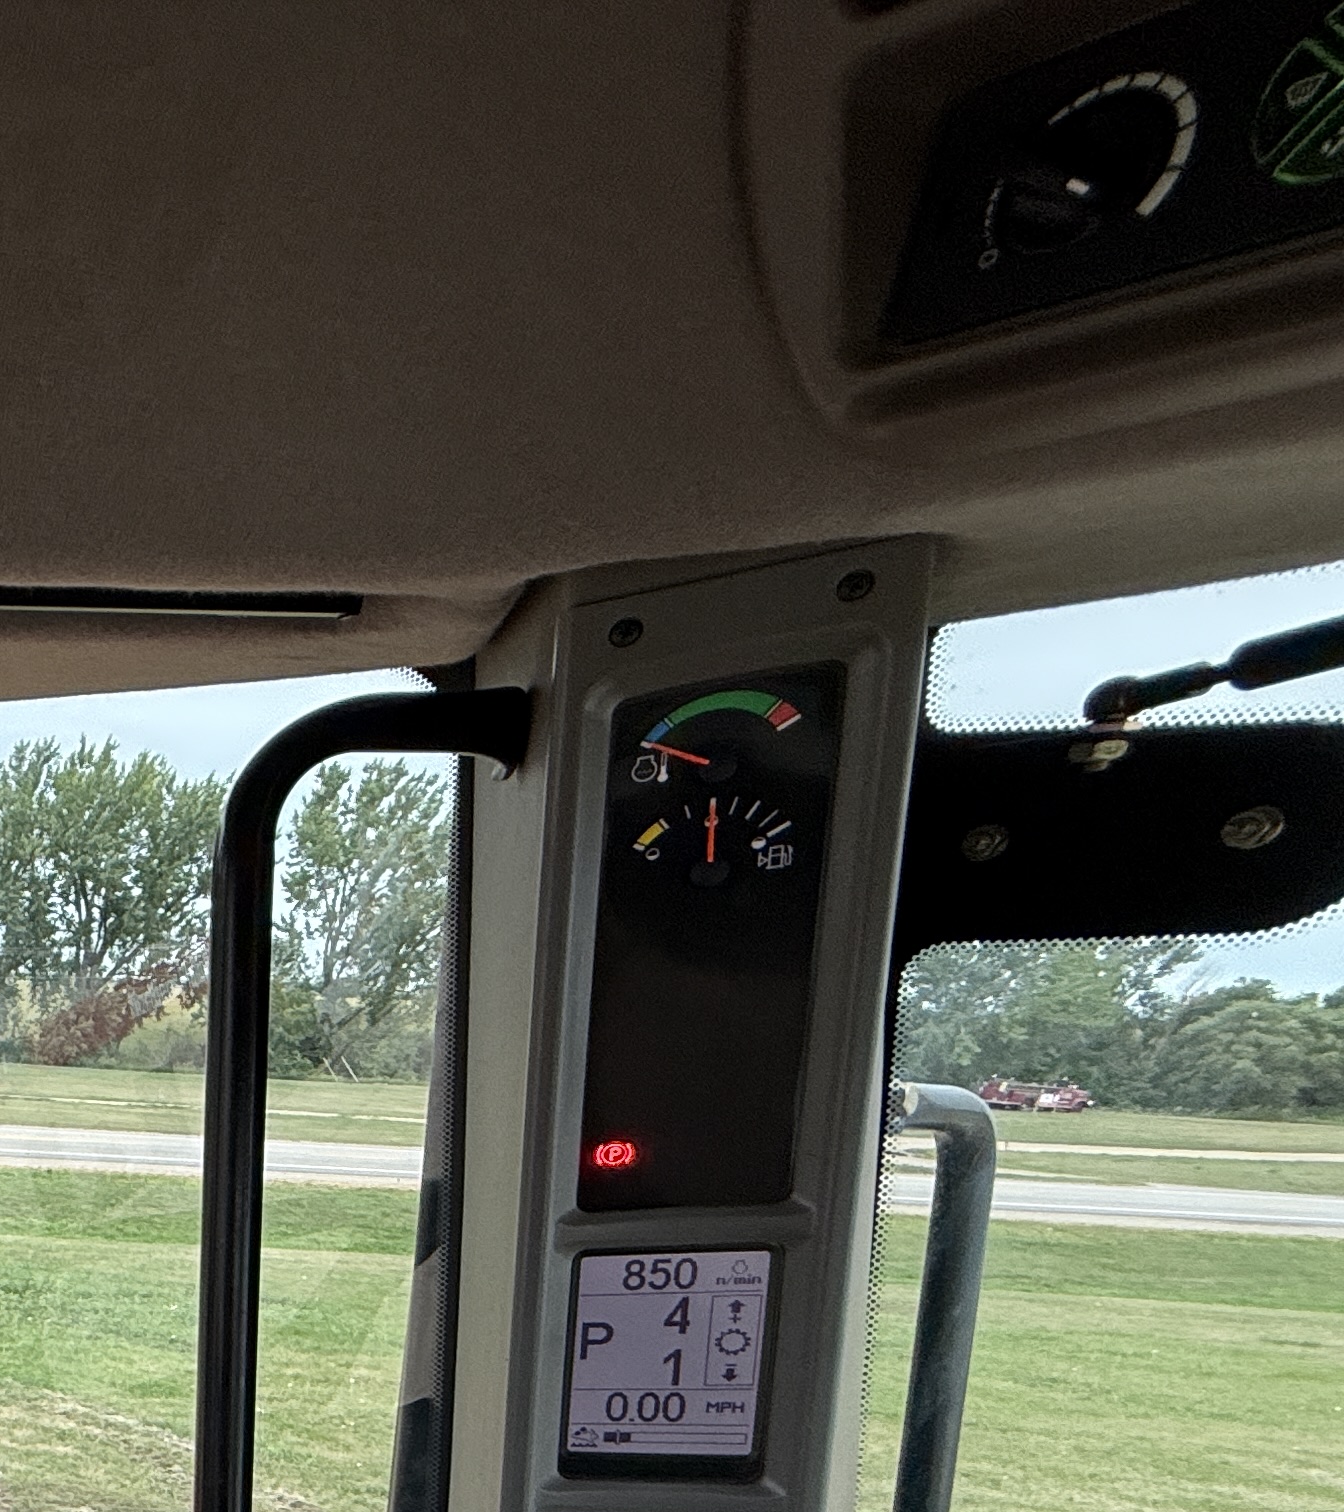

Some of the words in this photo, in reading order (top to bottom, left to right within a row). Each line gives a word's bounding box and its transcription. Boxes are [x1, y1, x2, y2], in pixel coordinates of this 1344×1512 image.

[622, 1257, 698, 1291] 850
[715, 1275, 761, 1286] n/min
[663, 1296, 690, 1335] 4
[579, 1322, 614, 1360] P
[663, 1349, 682, 1386] 1
[605, 1392, 686, 1422] 0.00
[705, 1401, 745, 1414] MPH
